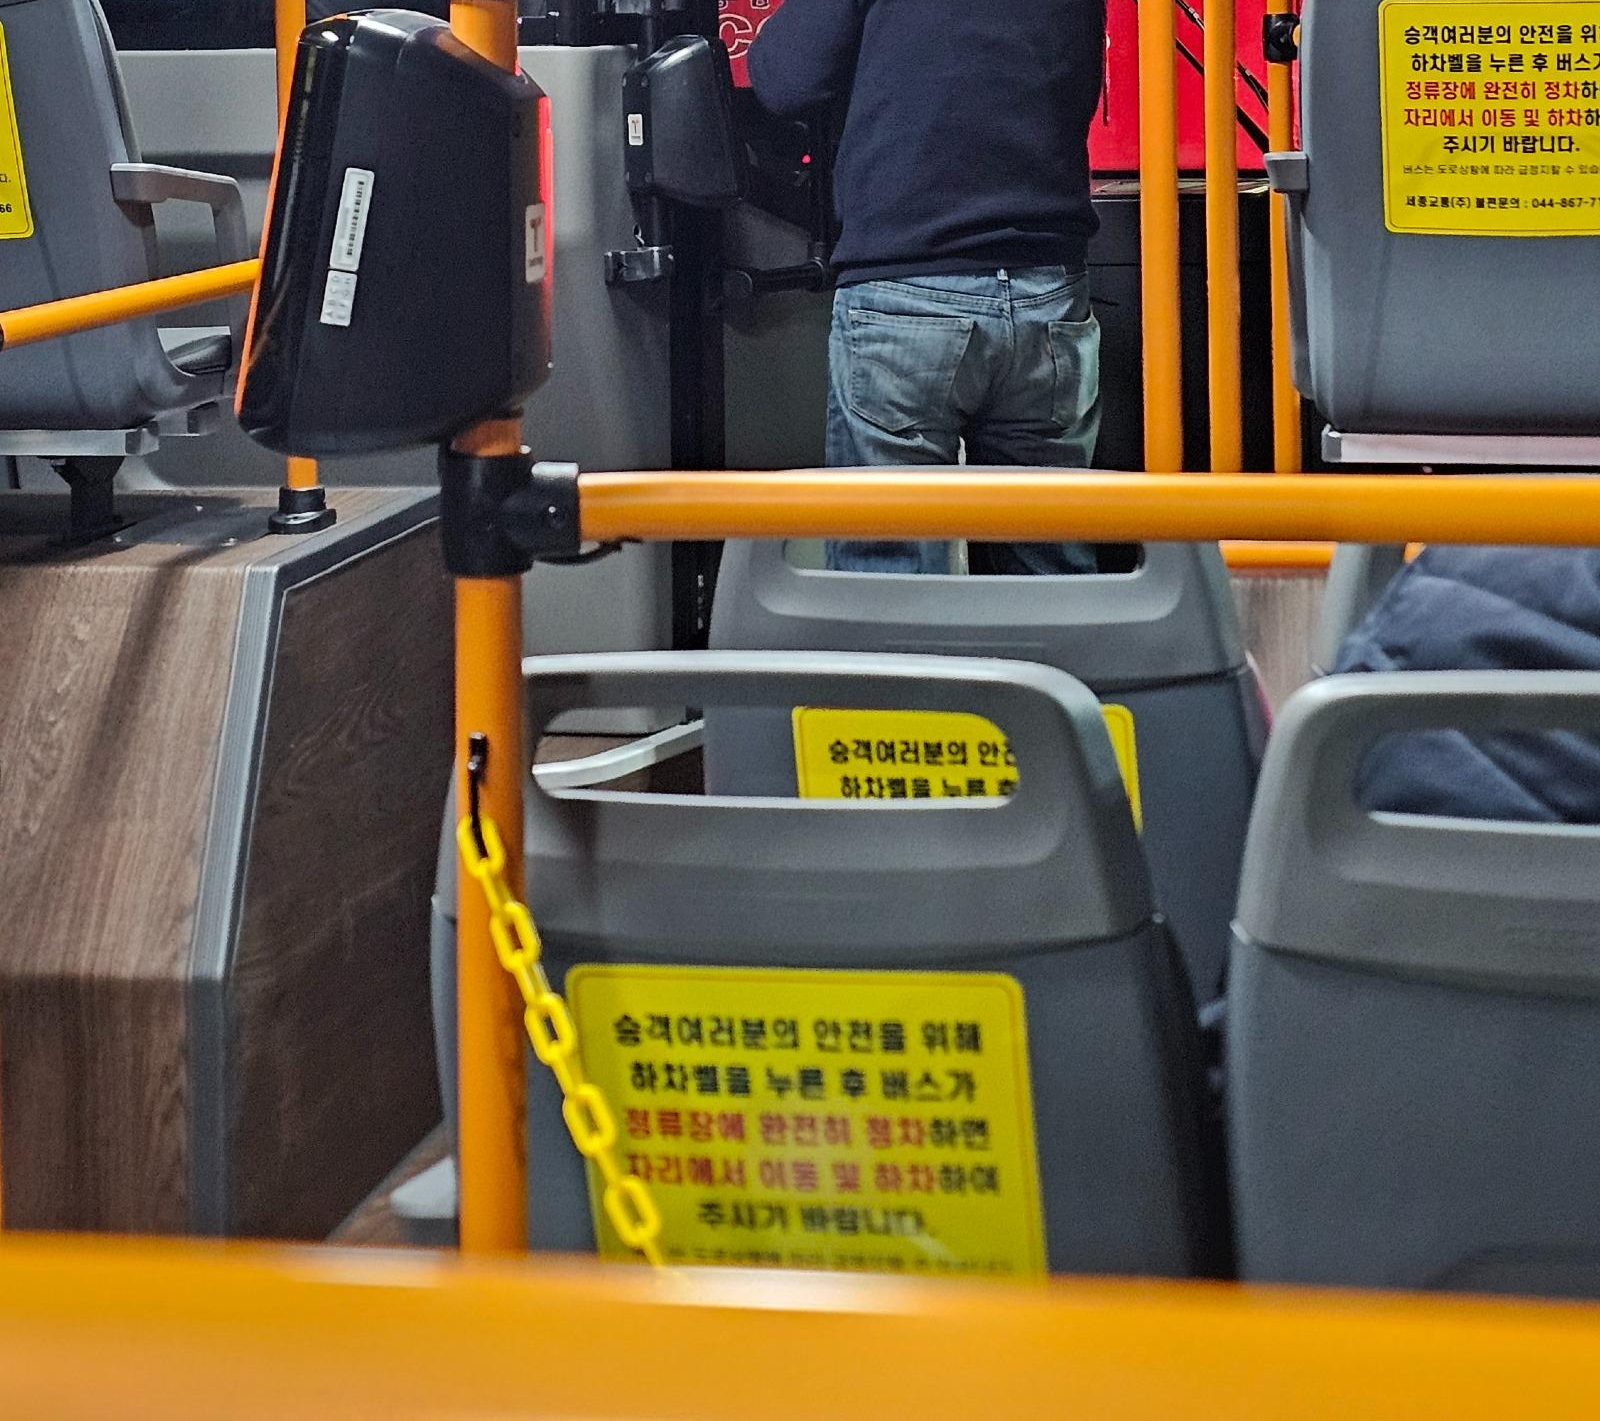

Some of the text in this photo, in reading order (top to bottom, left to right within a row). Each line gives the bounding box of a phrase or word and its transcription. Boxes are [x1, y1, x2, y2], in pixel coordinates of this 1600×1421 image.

[1404, 24, 1600, 45] 승객여러분의 안전을 위
[1411, 53, 1482, 72] 하차벨을
[1489, 53, 1524, 72] 누른
[1531, 52, 1548, 72] 후
[1405, 80, 1600, 100] 정류장에 완전히 정차하
[1403, 108, 1600, 127] 자리에서 이동 및 하차하
[1443, 135, 1581, 154] 주시기 바랍니다.
[1531, 197, 1600, 209] 044-867-7
[828, 740, 968, 766] 승객여러분의
[613, 1013, 982, 1054] 승객여러분의 안전을 위해
[630, 1061, 977, 1103] 하차벨을 누른 후 버스가
